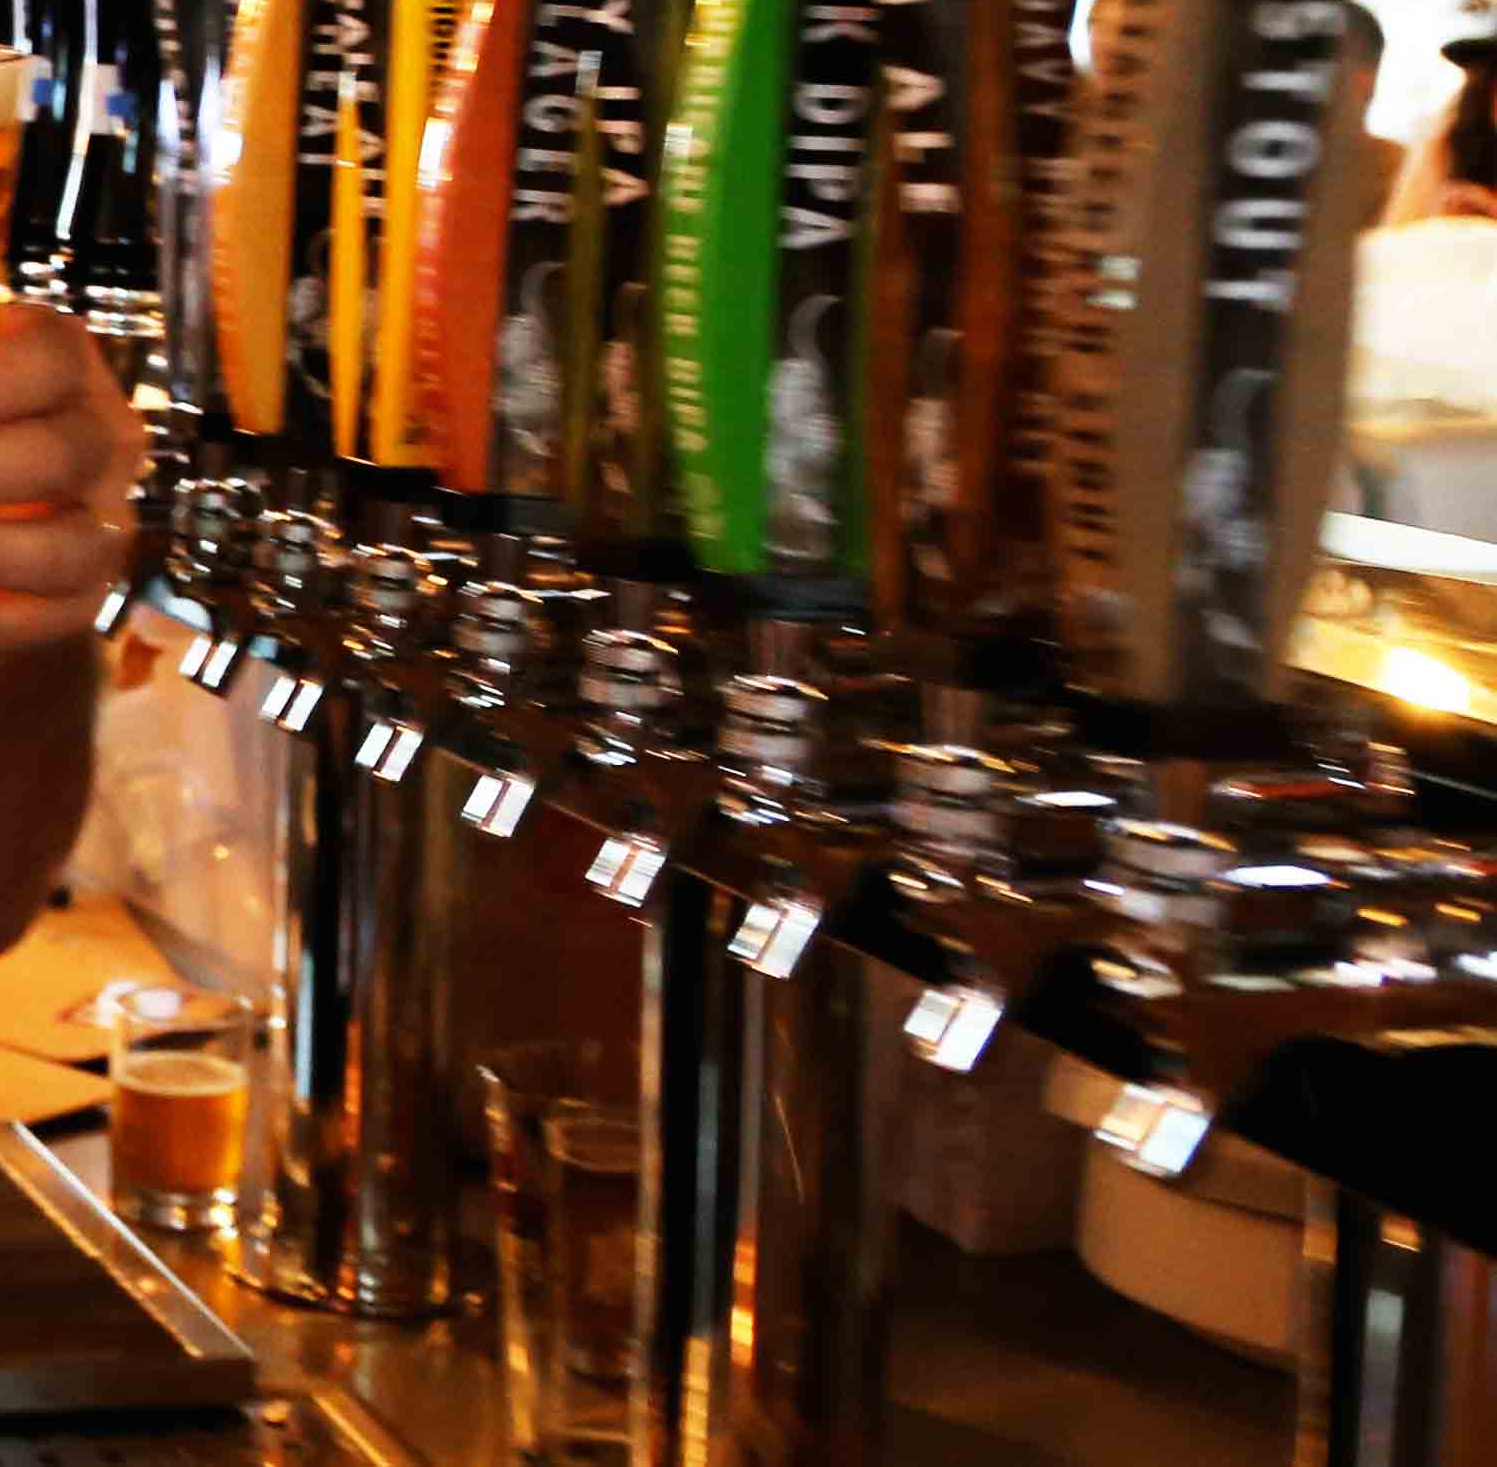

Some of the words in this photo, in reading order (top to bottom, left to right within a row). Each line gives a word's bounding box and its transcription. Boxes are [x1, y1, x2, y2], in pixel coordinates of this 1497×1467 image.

[507, 0, 590, 221] LAGER
[590, 84, 654, 207] IPA
[776, 82, 868, 250] DIPA
[880, 63, 963, 214] ALE
